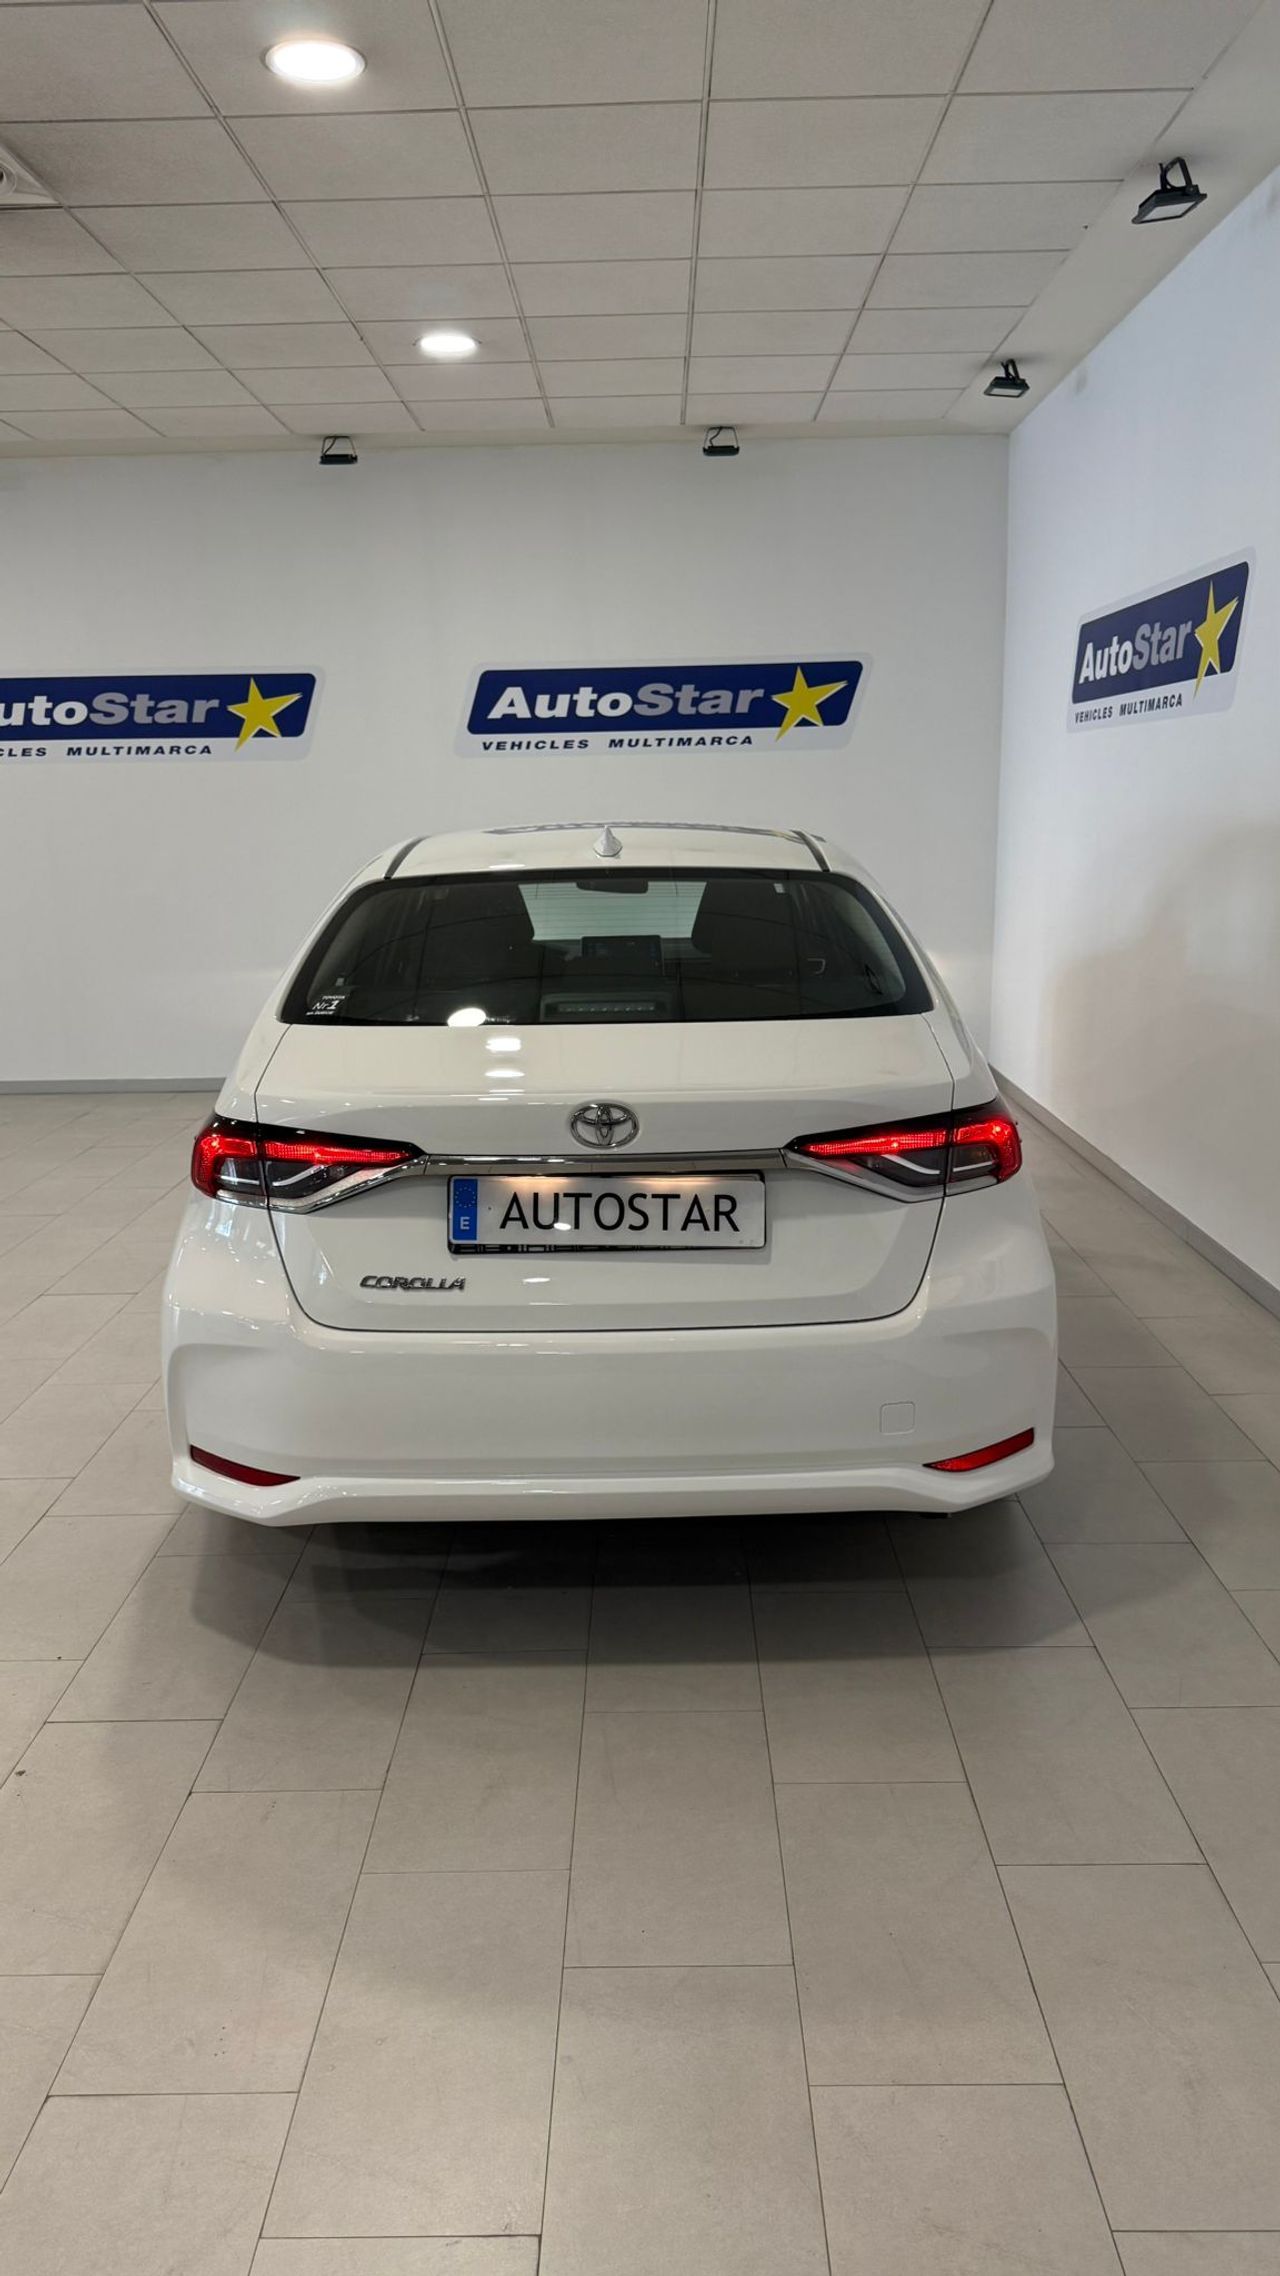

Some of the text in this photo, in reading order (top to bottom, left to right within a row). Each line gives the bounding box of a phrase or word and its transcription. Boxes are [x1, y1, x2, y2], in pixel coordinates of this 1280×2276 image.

[1078, 620, 1193, 685] AutoStar
[486, 682, 765, 719] AutoStar
[1074, 692, 1182, 723] VEHICLES MULTIMARCA
[66, 745, 212, 756] MULTIMARCA
[482, 735, 753, 750] VEHICLES MULTIMARCA
[460, 1191, 741, 1233] E AUTOSTAR
[360, 1275, 466, 1291] COROLLA
